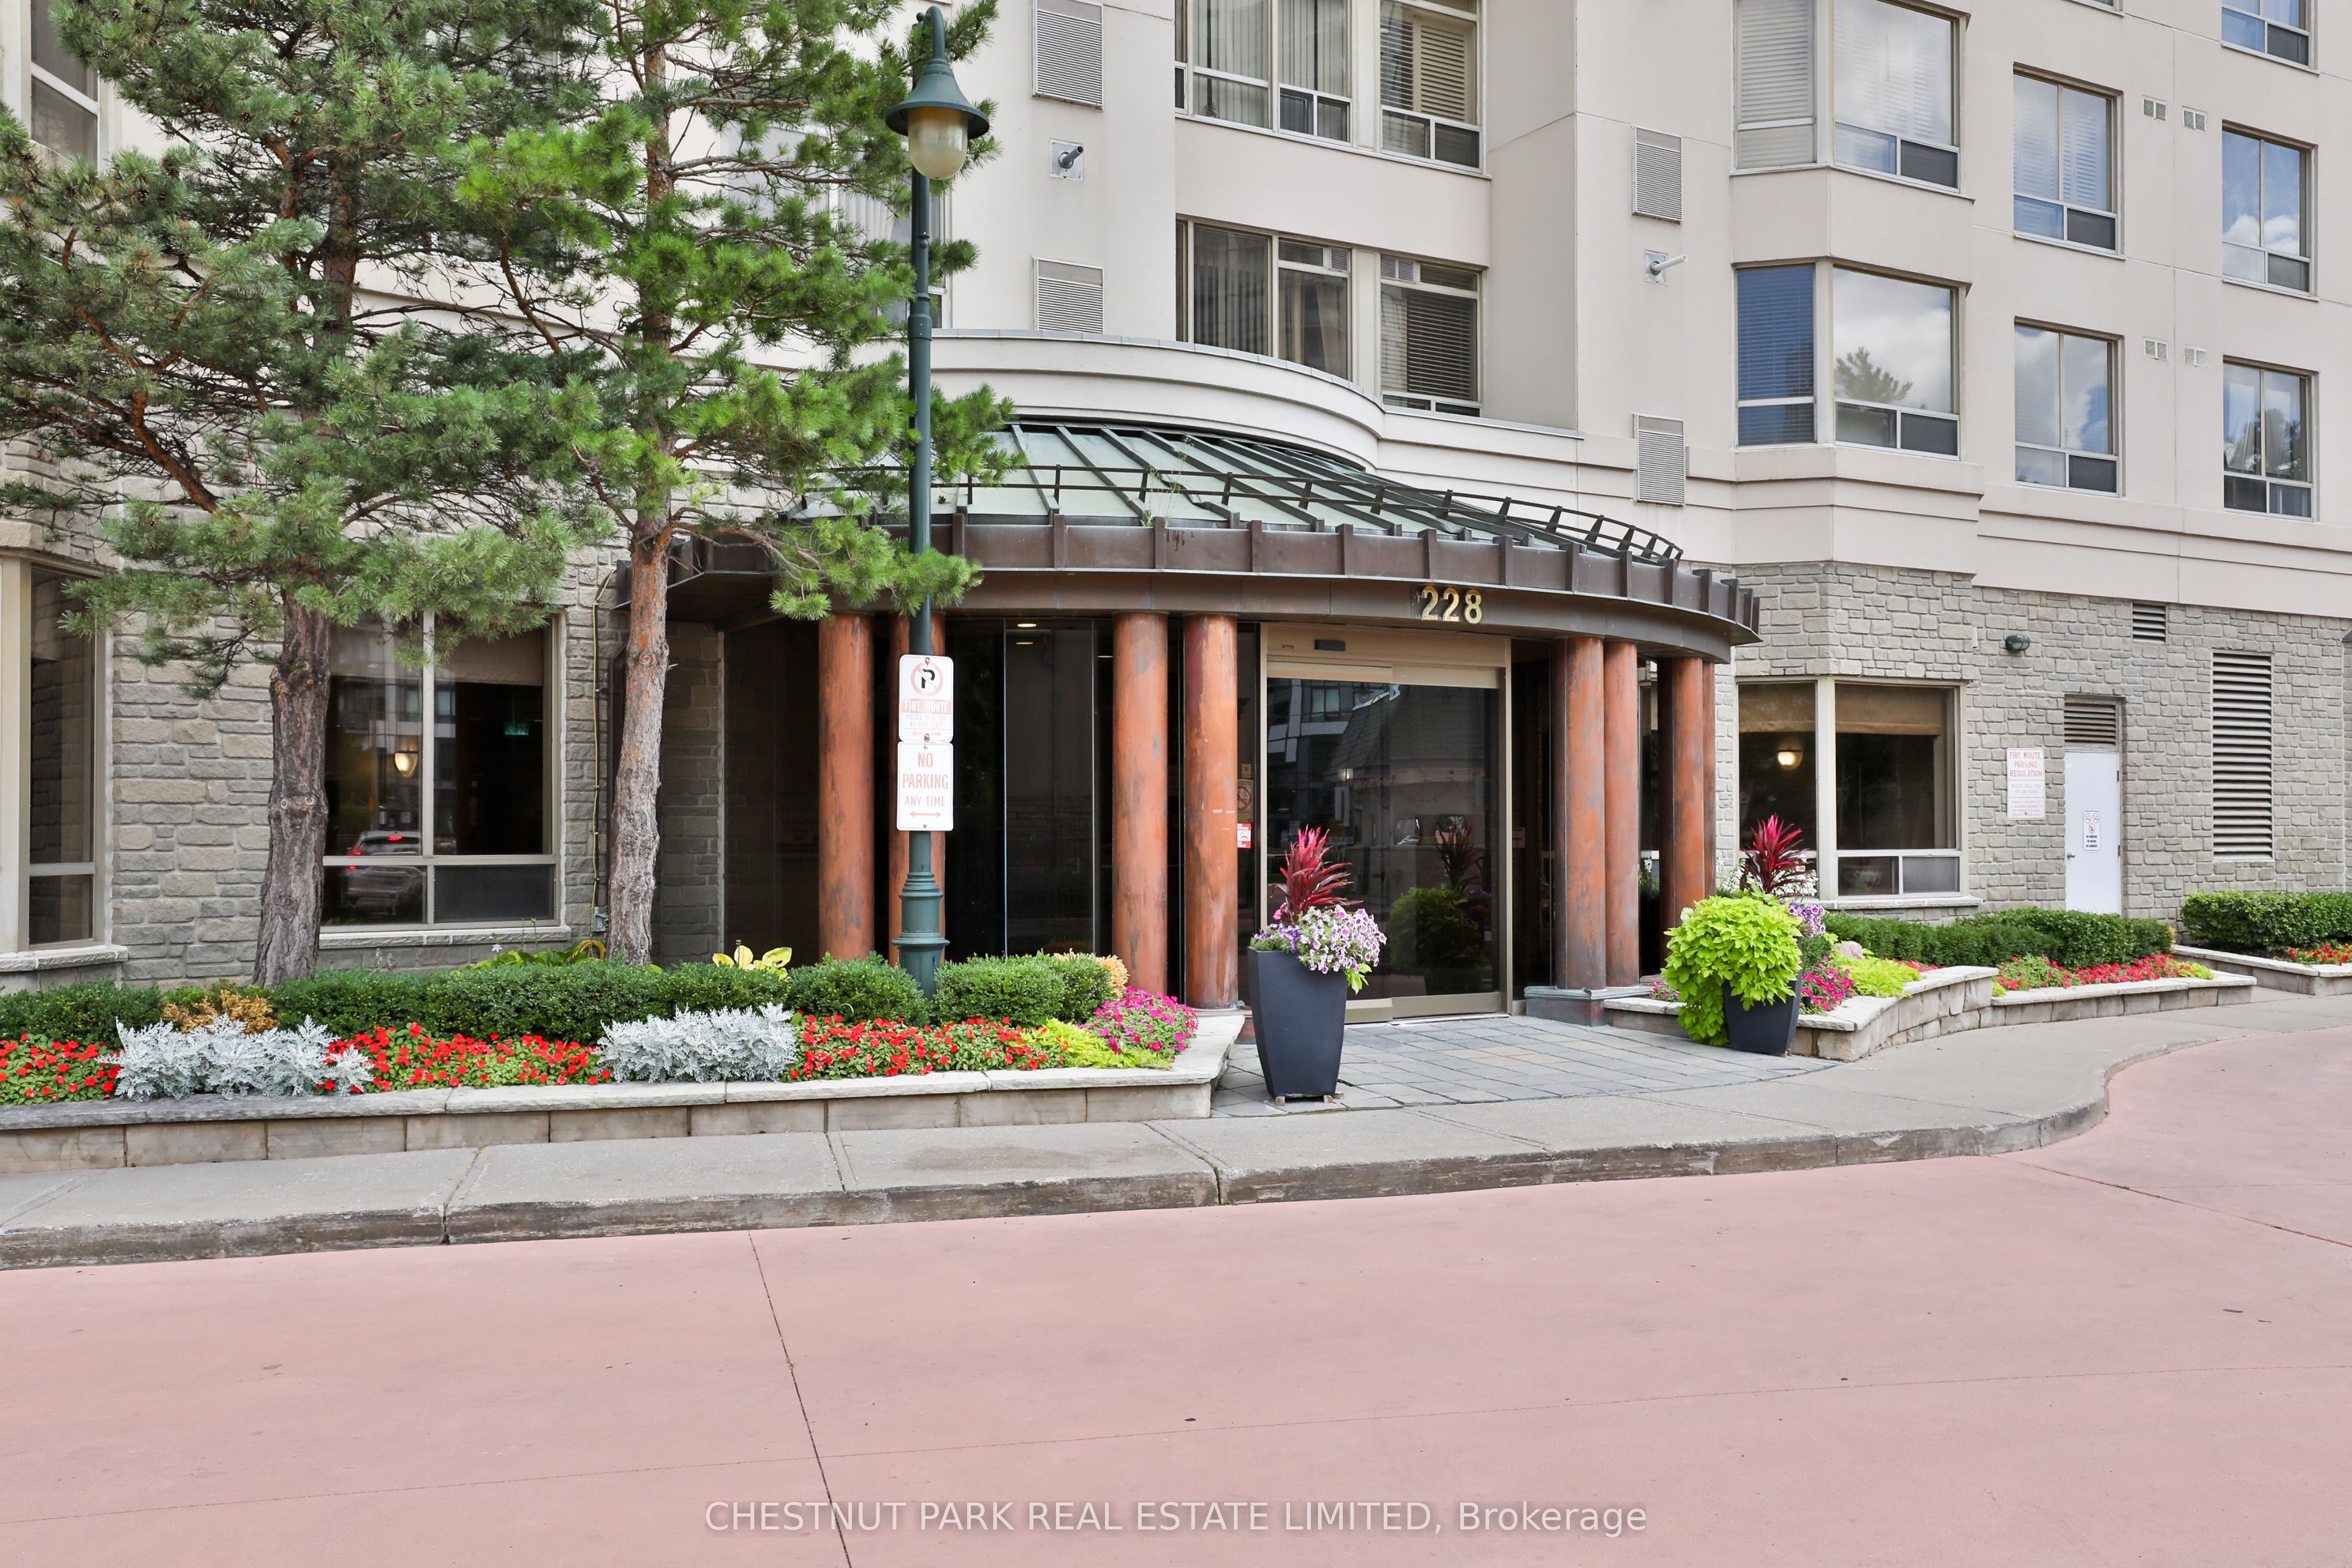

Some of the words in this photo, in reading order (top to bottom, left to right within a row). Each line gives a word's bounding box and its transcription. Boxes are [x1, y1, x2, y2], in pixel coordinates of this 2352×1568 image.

[1421, 586, 1482, 624] 228
[904, 700, 921, 712] FIRE
[925, 701, 948, 713] ROUTE
[918, 752, 933, 767] NO
[902, 774, 949, 790] PARKING
[904, 795, 922, 806] ANY
[925, 796, 946, 807] TIME
